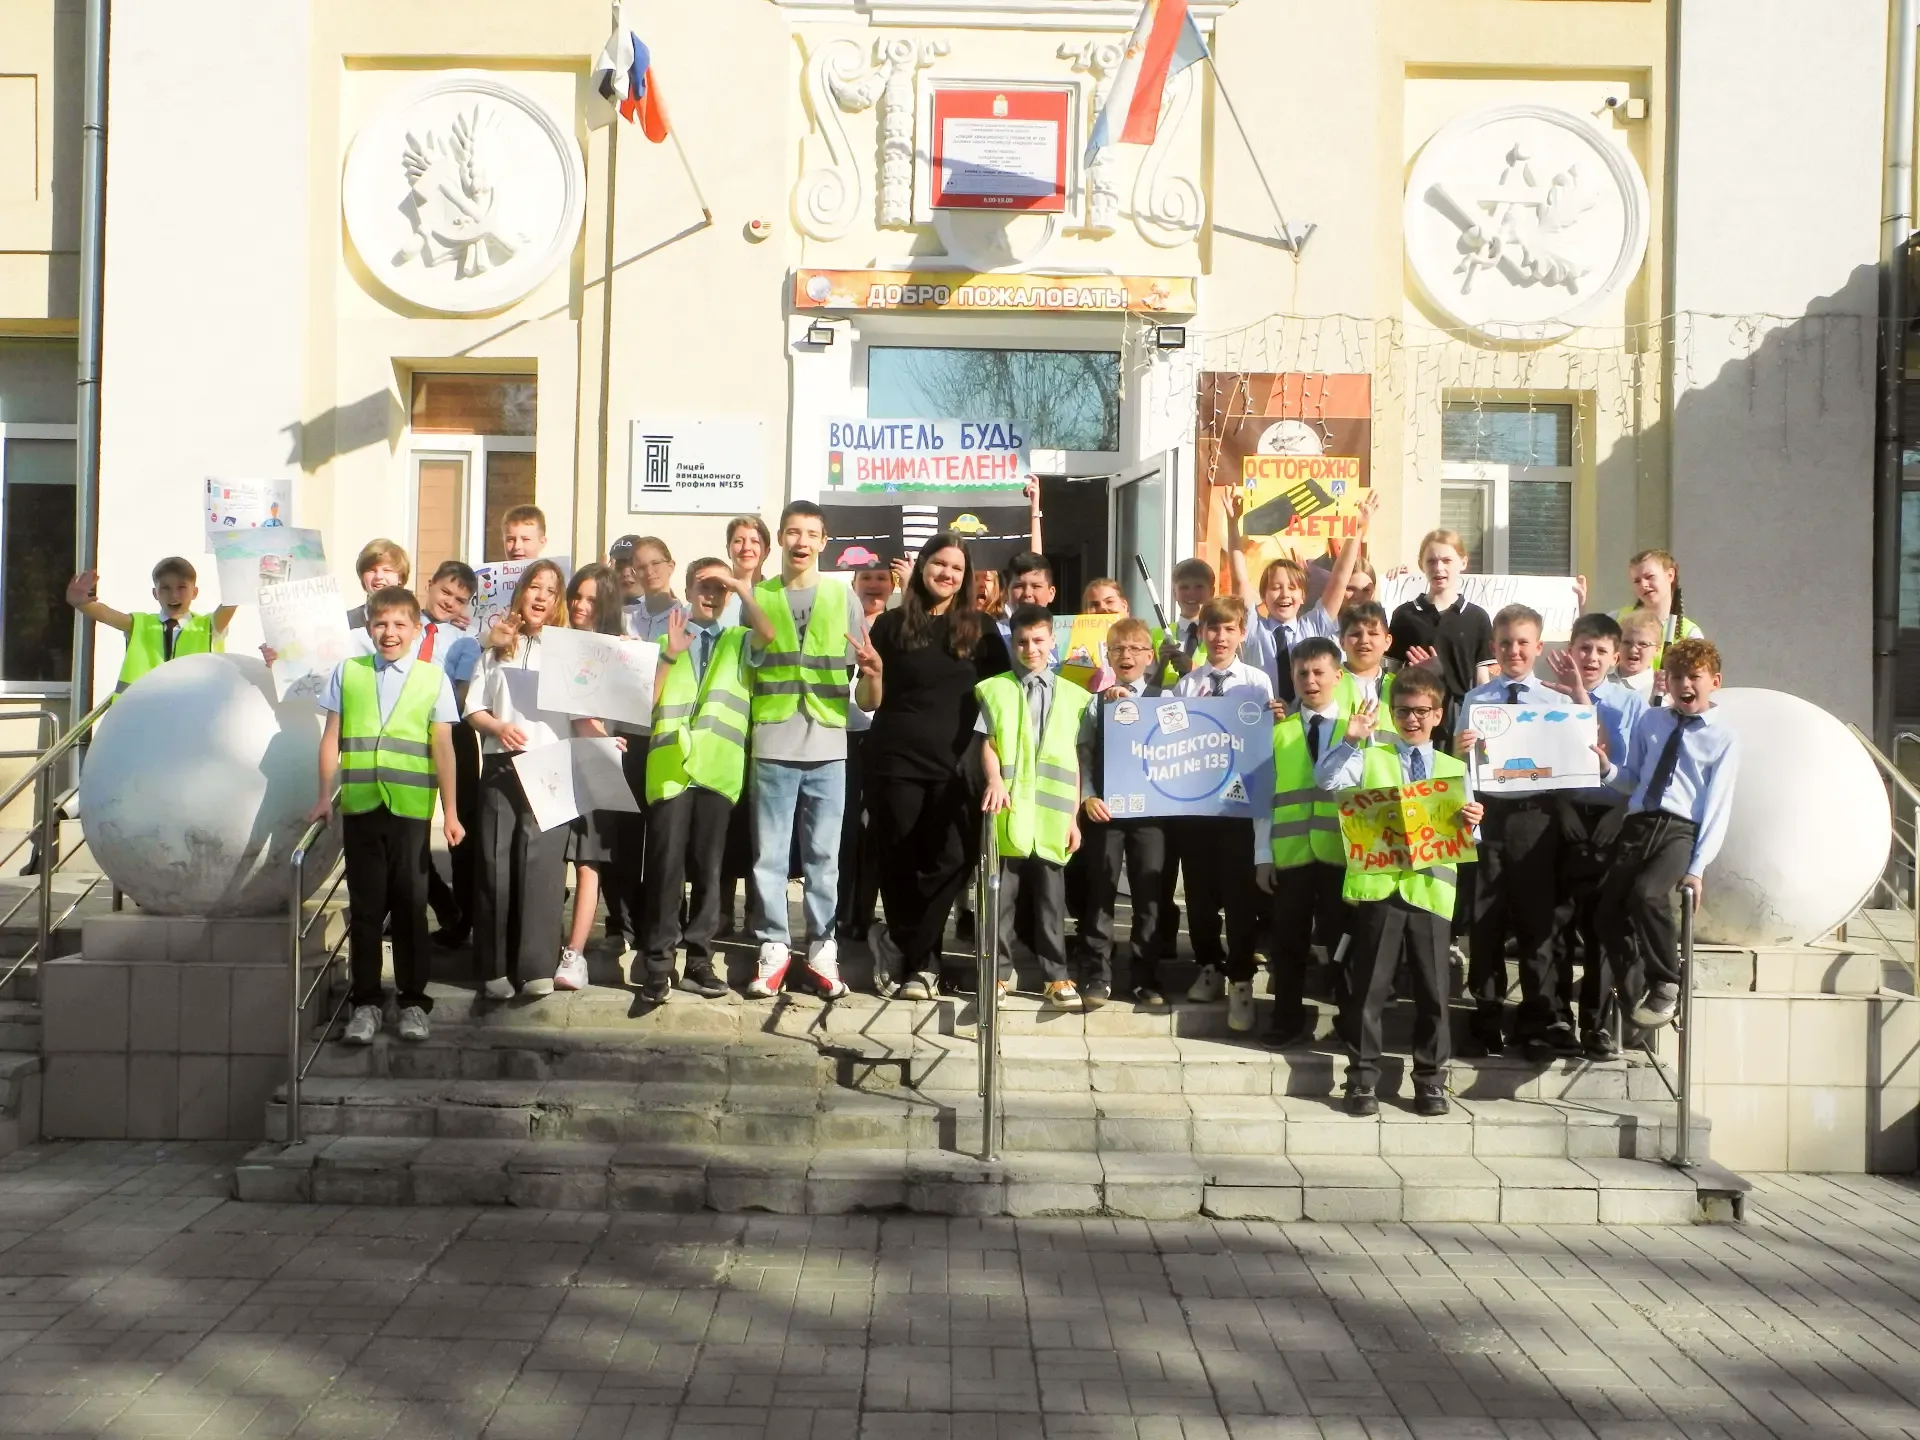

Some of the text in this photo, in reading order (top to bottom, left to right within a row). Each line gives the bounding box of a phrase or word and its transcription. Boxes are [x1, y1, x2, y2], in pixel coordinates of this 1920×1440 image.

[866, 284, 1129, 308] ДОБРО ПОЖАЛОВАТЬ!
[829, 422, 1023, 451] ВОДИТЕЛЬ БУДЬ
[675, 472, 741, 480] авиационного
[676, 462, 705, 471] Лицей
[856, 453, 1018, 481] ВНИМАТЕЛЕН!
[1244, 458, 1360, 480] ОСТОРОЖНО
[1285, 514, 1357, 538] ДЕТИ
[1131, 732, 1244, 761] ИНСПЕКТОРЫ
[1146, 753, 1229, 782] ЛАП № 135
